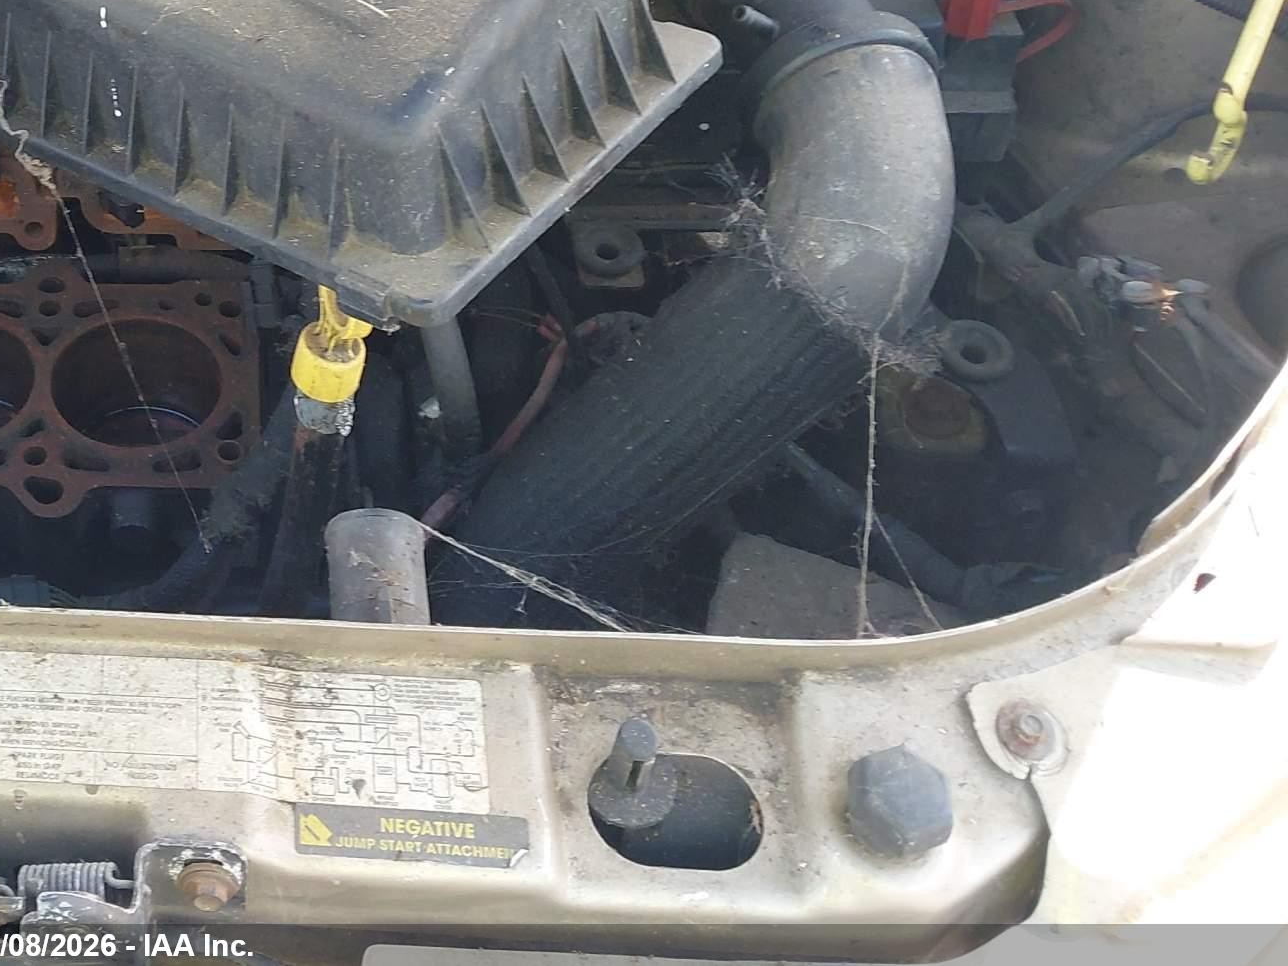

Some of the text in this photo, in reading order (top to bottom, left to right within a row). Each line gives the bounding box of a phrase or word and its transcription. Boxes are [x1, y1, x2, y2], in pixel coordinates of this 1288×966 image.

[379, 817, 475, 840] NEGATIVE
[335, 836, 514, 860] JUMP START ATTACHMEN
